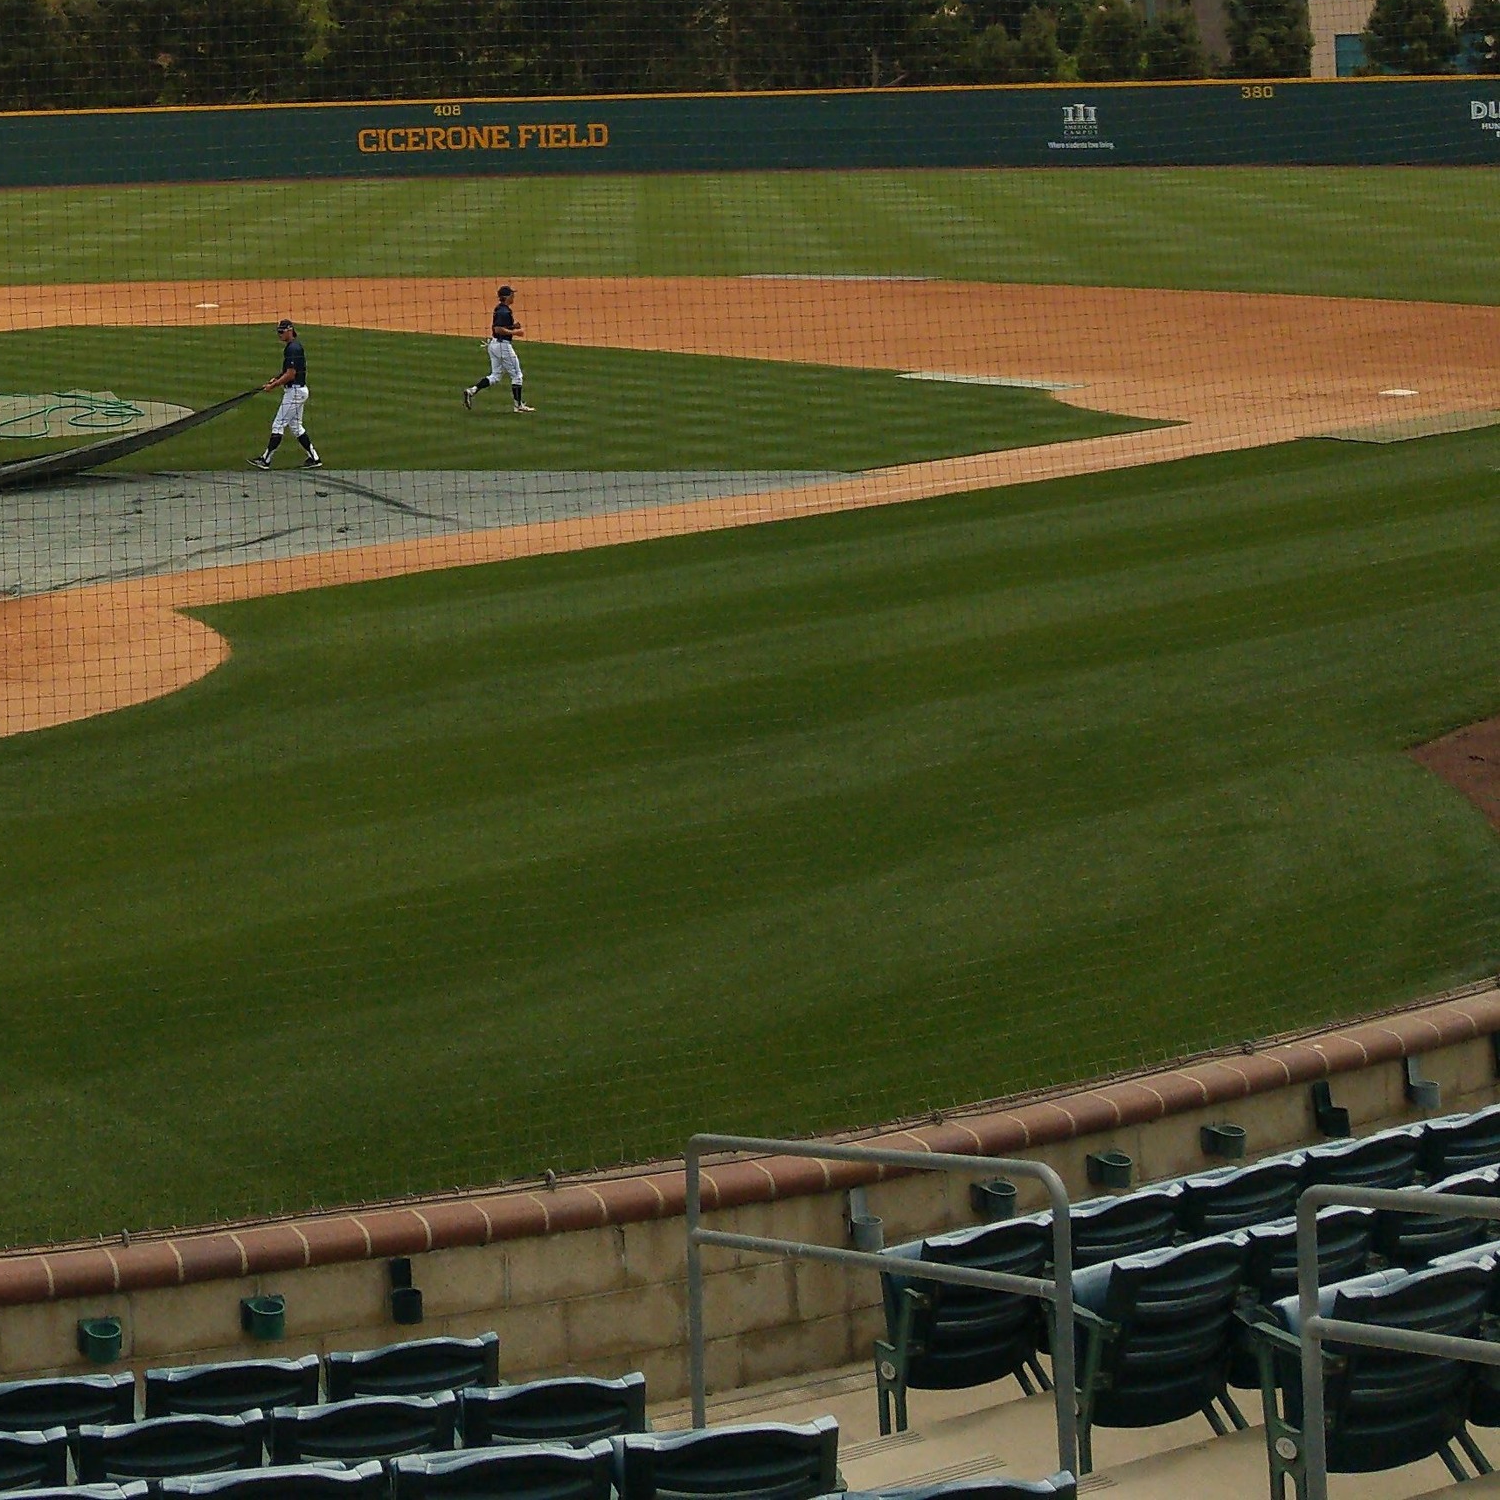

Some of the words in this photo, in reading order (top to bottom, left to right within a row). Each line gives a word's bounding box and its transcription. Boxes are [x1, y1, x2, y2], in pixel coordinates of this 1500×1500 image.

[1241, 85, 1273, 99] 380
[433, 105, 461, 116] 408
[358, 125, 510, 153] CICERONE
[518, 123, 609, 149] FIELD
